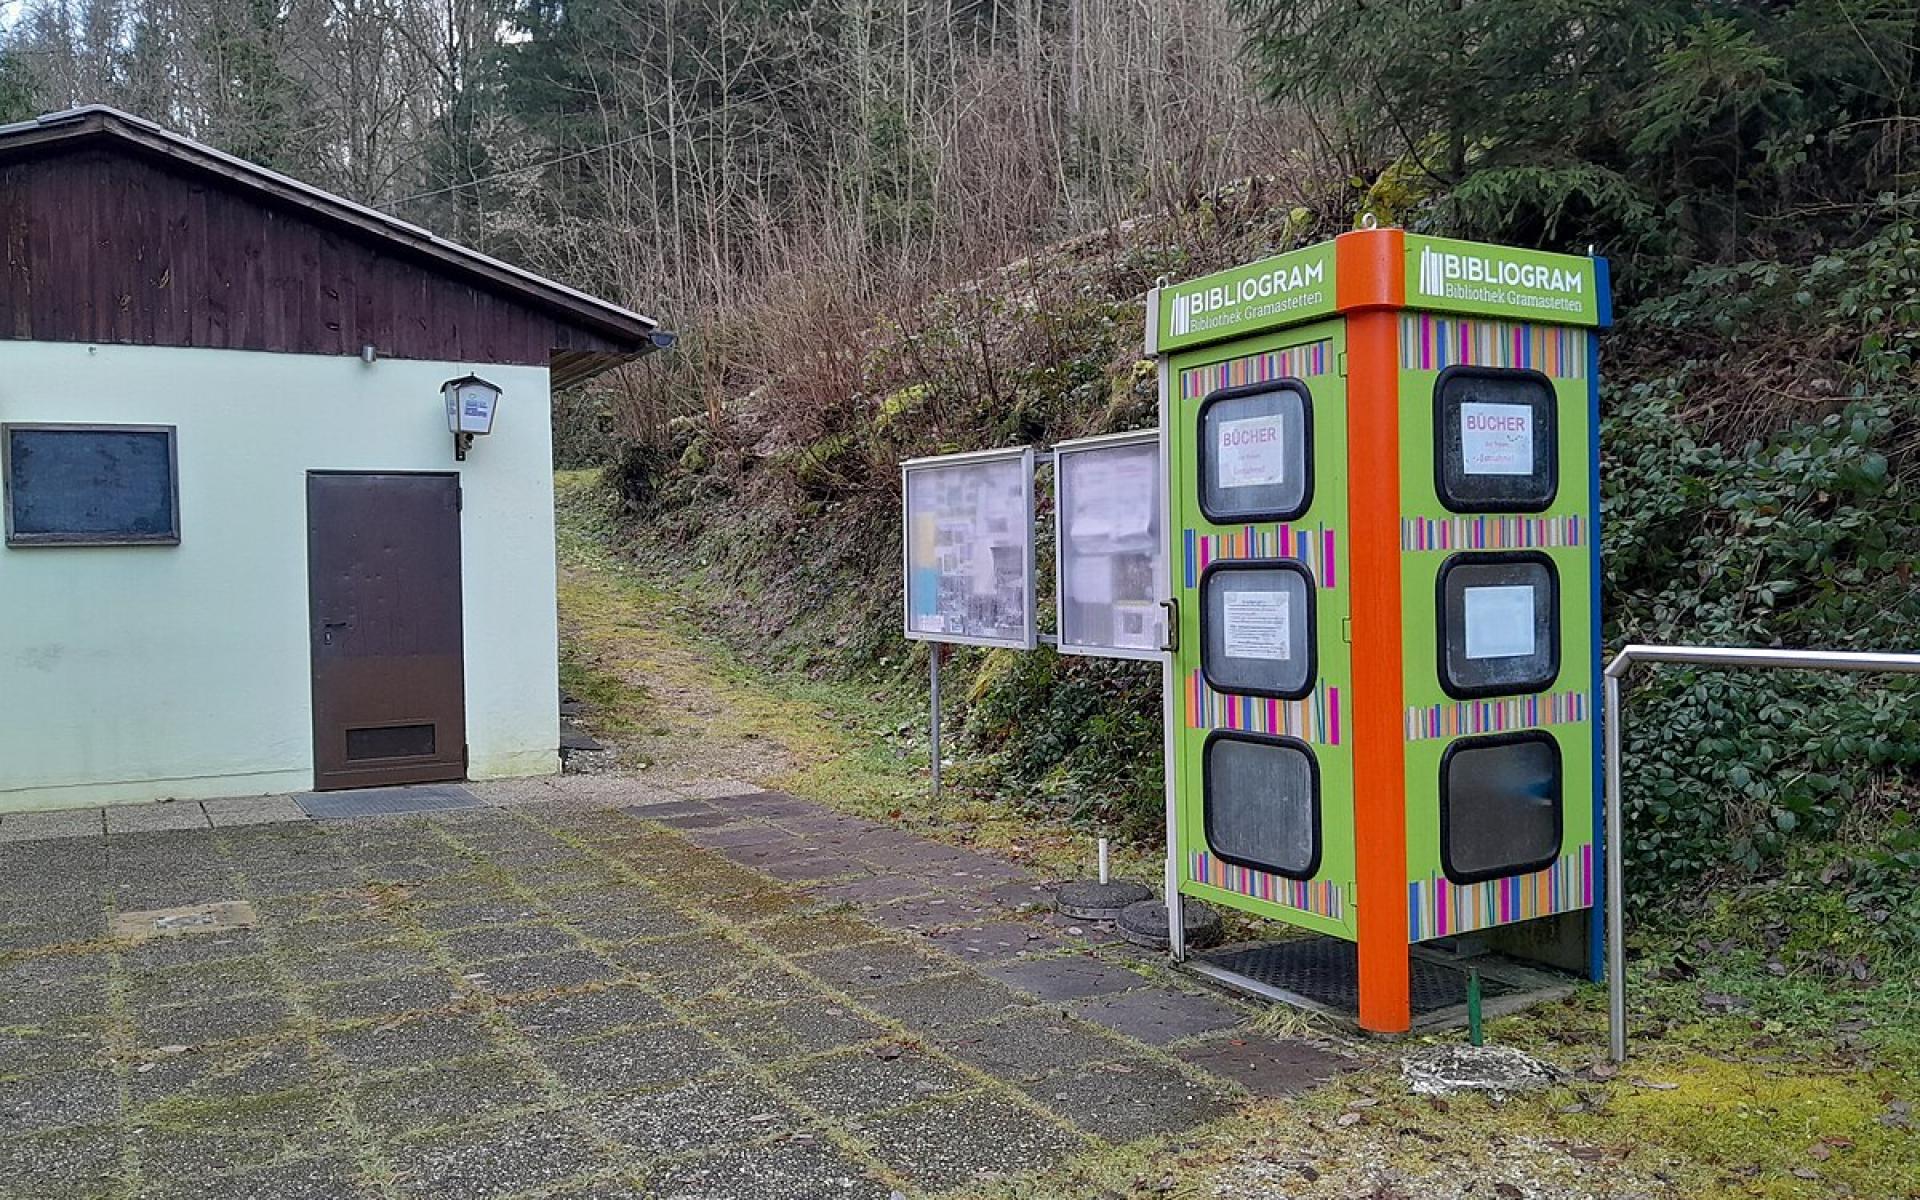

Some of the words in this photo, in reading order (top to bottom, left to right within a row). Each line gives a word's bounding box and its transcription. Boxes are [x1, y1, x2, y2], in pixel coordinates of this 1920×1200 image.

[1190, 259, 1323, 315] BIBLIOGRAM
[1445, 254, 1582, 293] BIBLIOGRAM
[1190, 308, 1242, 332] Bibliothek
[1244, 291, 1322, 321] Gramastetten
[1445, 283, 1505, 304] Bibliothek
[1507, 290, 1583, 312] Gramastetten
[1223, 427, 1277, 447] BÜCHER
[1466, 412, 1525, 432] BÜCHER
